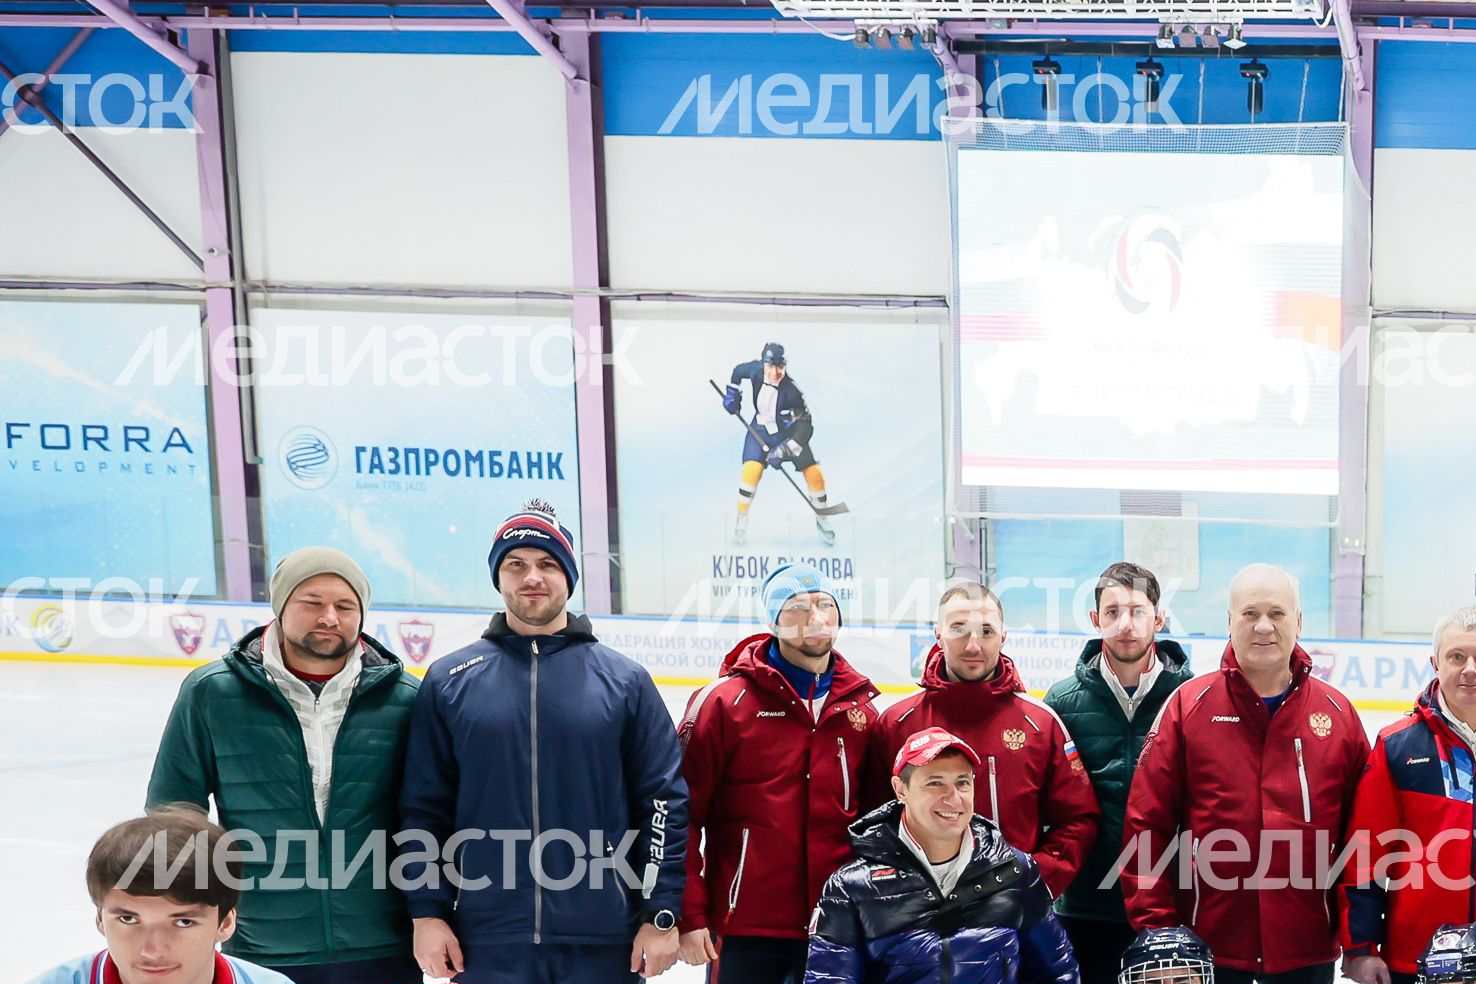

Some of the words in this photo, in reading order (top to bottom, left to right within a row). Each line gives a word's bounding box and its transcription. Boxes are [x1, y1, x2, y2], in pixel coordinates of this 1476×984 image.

[6, 423, 194, 453] FORRA
[355, 446, 565, 480] ГАЗПРОМБАНК
[650, 799, 669, 864] AUER
